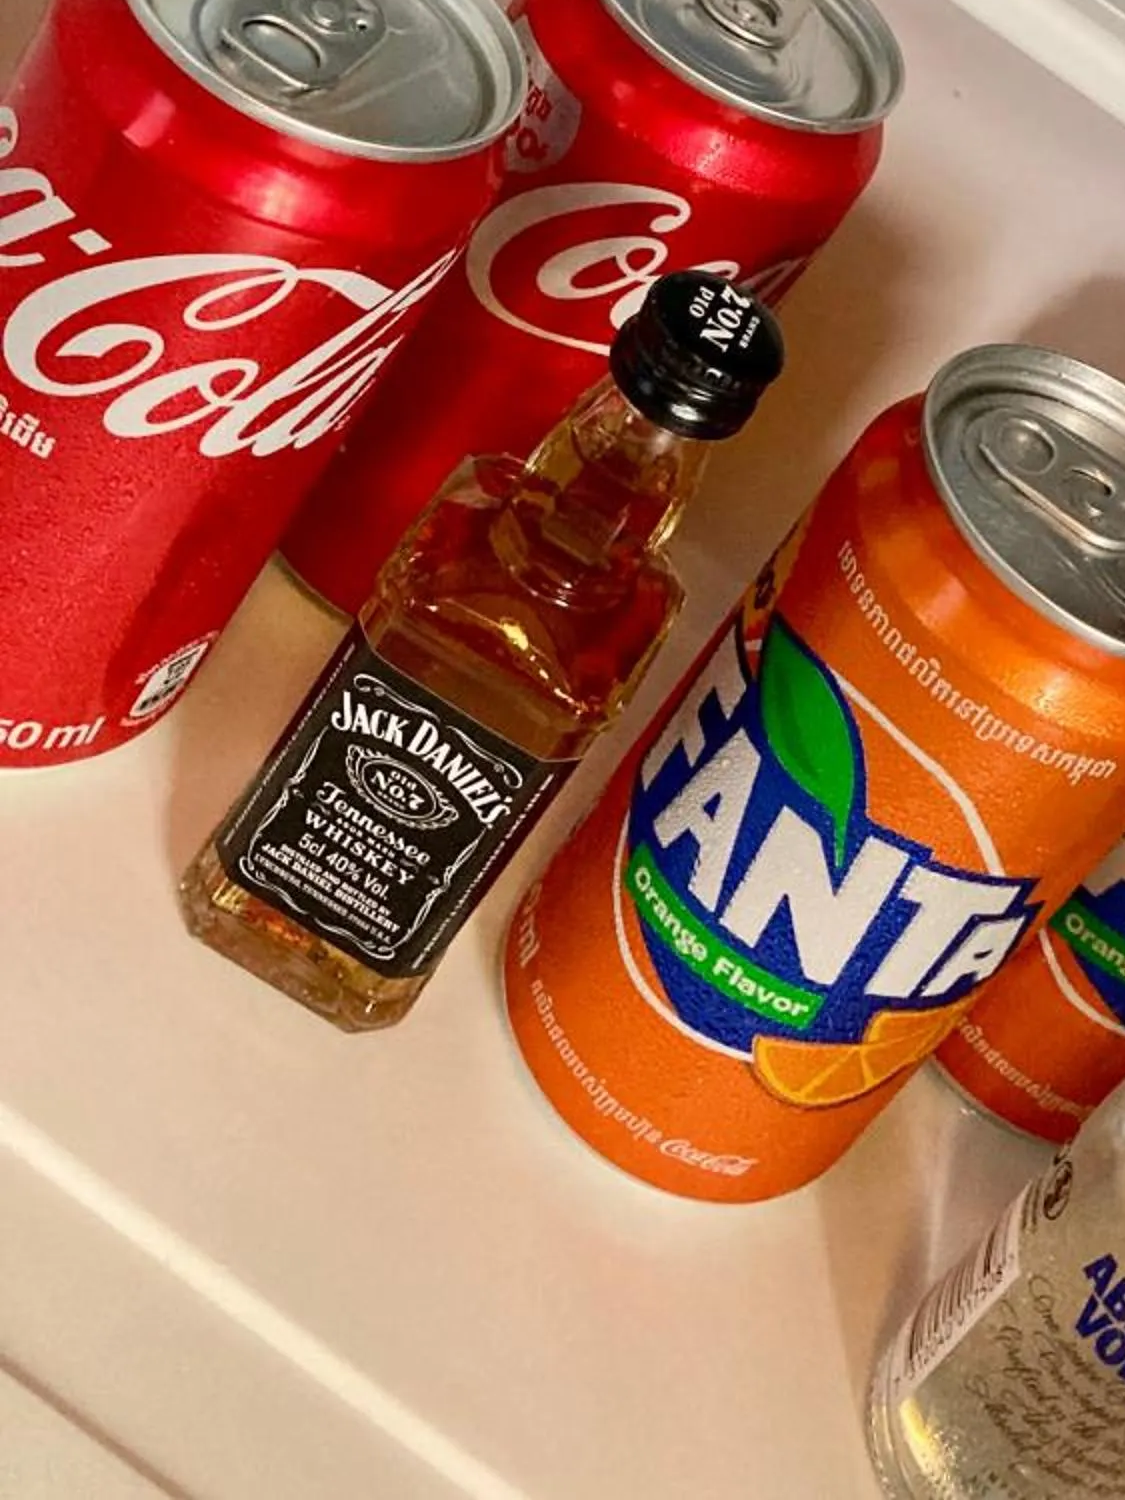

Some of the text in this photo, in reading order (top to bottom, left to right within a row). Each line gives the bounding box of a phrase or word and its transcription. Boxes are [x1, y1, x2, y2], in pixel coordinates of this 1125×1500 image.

[689, 286, 716, 318] Old
[43, 717, 106, 749] ml
[330, 691, 411, 748] JACK
[406, 719, 511, 827] DANIEL'S
[304, 810, 415, 885] WHISKEY
[316, 781, 431, 866] Tennessee
[641, 626, 1026, 998] FANTA
[260, 840, 292, 865] JACK
[290, 860, 334, 892] DANIEL
[332, 887, 401, 934] DISTILLERY
[298, 833, 390, 901] 5cl 40% Vol.
[633, 867, 708, 961] Orange
[713, 950, 810, 1017] Flavor
